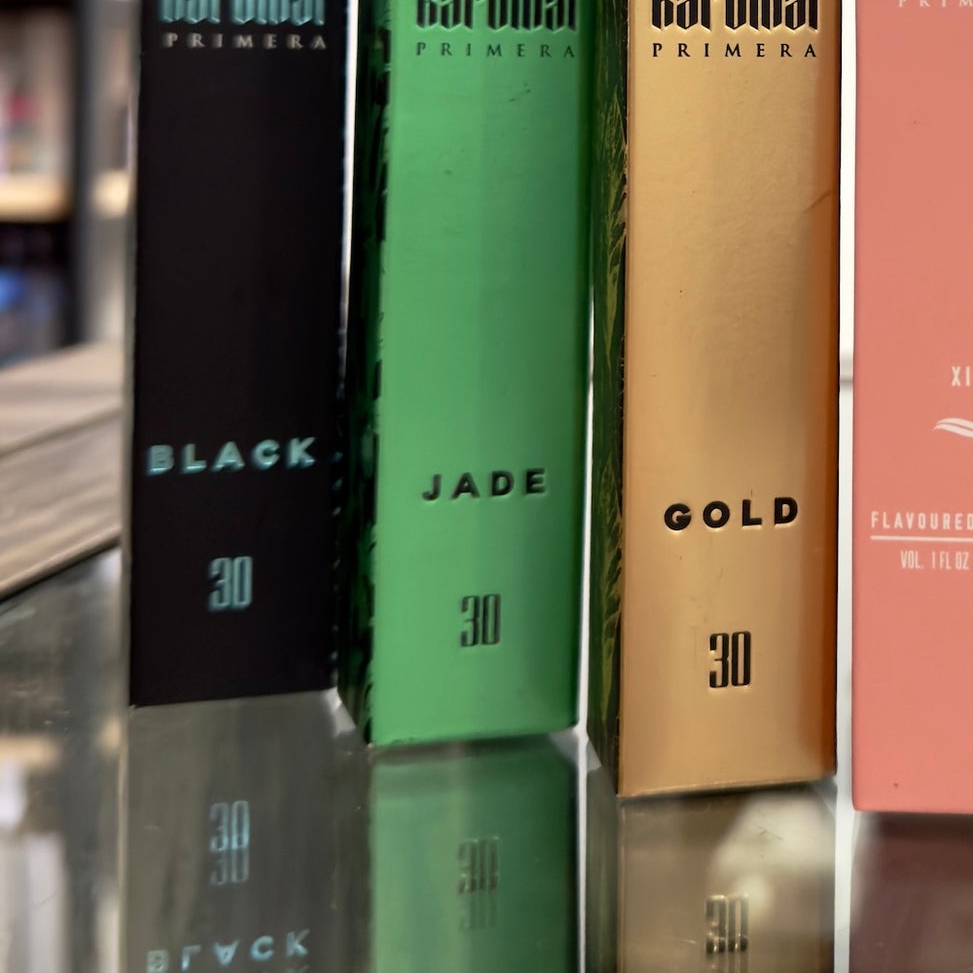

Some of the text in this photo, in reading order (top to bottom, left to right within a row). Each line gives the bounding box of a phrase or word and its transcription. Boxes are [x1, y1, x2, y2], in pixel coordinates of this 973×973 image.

[163, 32, 326, 50] PRIMERA
[416, 42, 576, 58] PRIMERA
[652, 43, 817, 58] PRIMERA
[147, 436, 317, 476] BLACK
[422, 467, 547, 502] JADE
[664, 496, 798, 532] GOLD
[900, 550, 924, 569] VOL.
[940, 551, 952, 570] FL
[955, 552, 969, 570] OZ
[208, 555, 254, 611] 30
[460, 594, 501, 648] 30
[708, 631, 752, 689] 30
